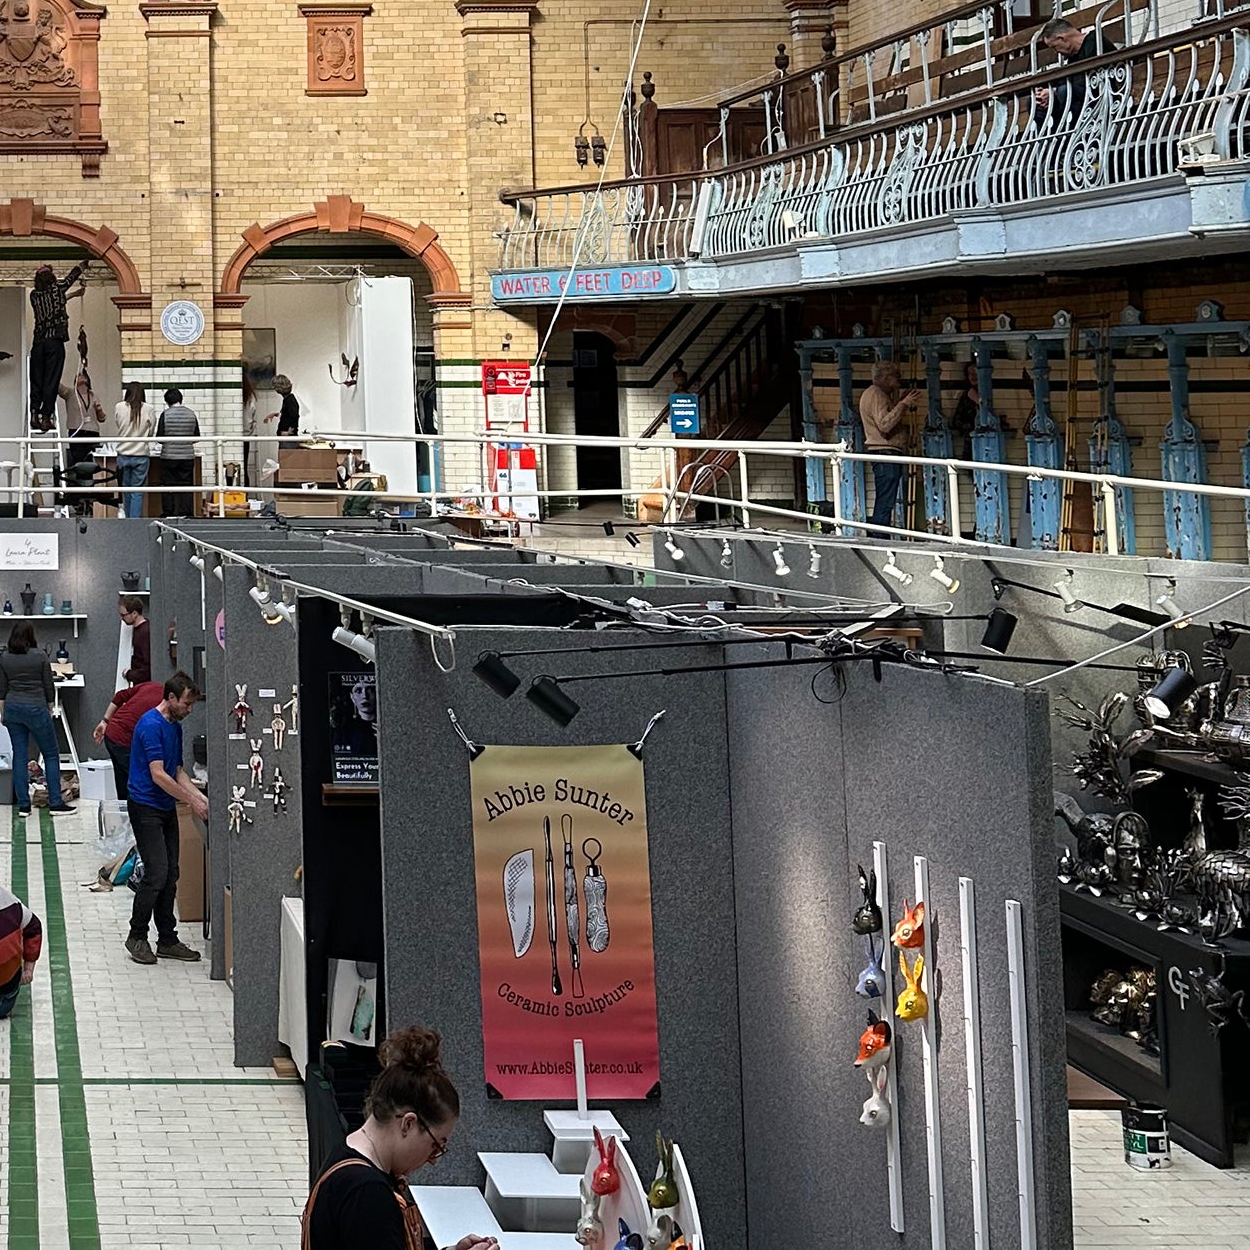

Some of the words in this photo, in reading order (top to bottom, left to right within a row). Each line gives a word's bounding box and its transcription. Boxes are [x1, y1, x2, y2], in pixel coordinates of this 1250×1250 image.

[500, 276, 551, 296] WATER
[575, 273, 611, 292] FEET
[621, 271, 662, 291] DEEP
[170, 316, 195, 327] QEST
[335, 762, 362, 771] Express
[483, 781, 546, 822] Abbie
[554, 778, 634, 826] Sunter
[497, 982, 560, 1017] Ceramic
[564, 979, 635, 1017] Sculpture
[496, 1061, 644, 1075] www.AbbieSnter.co.uk
